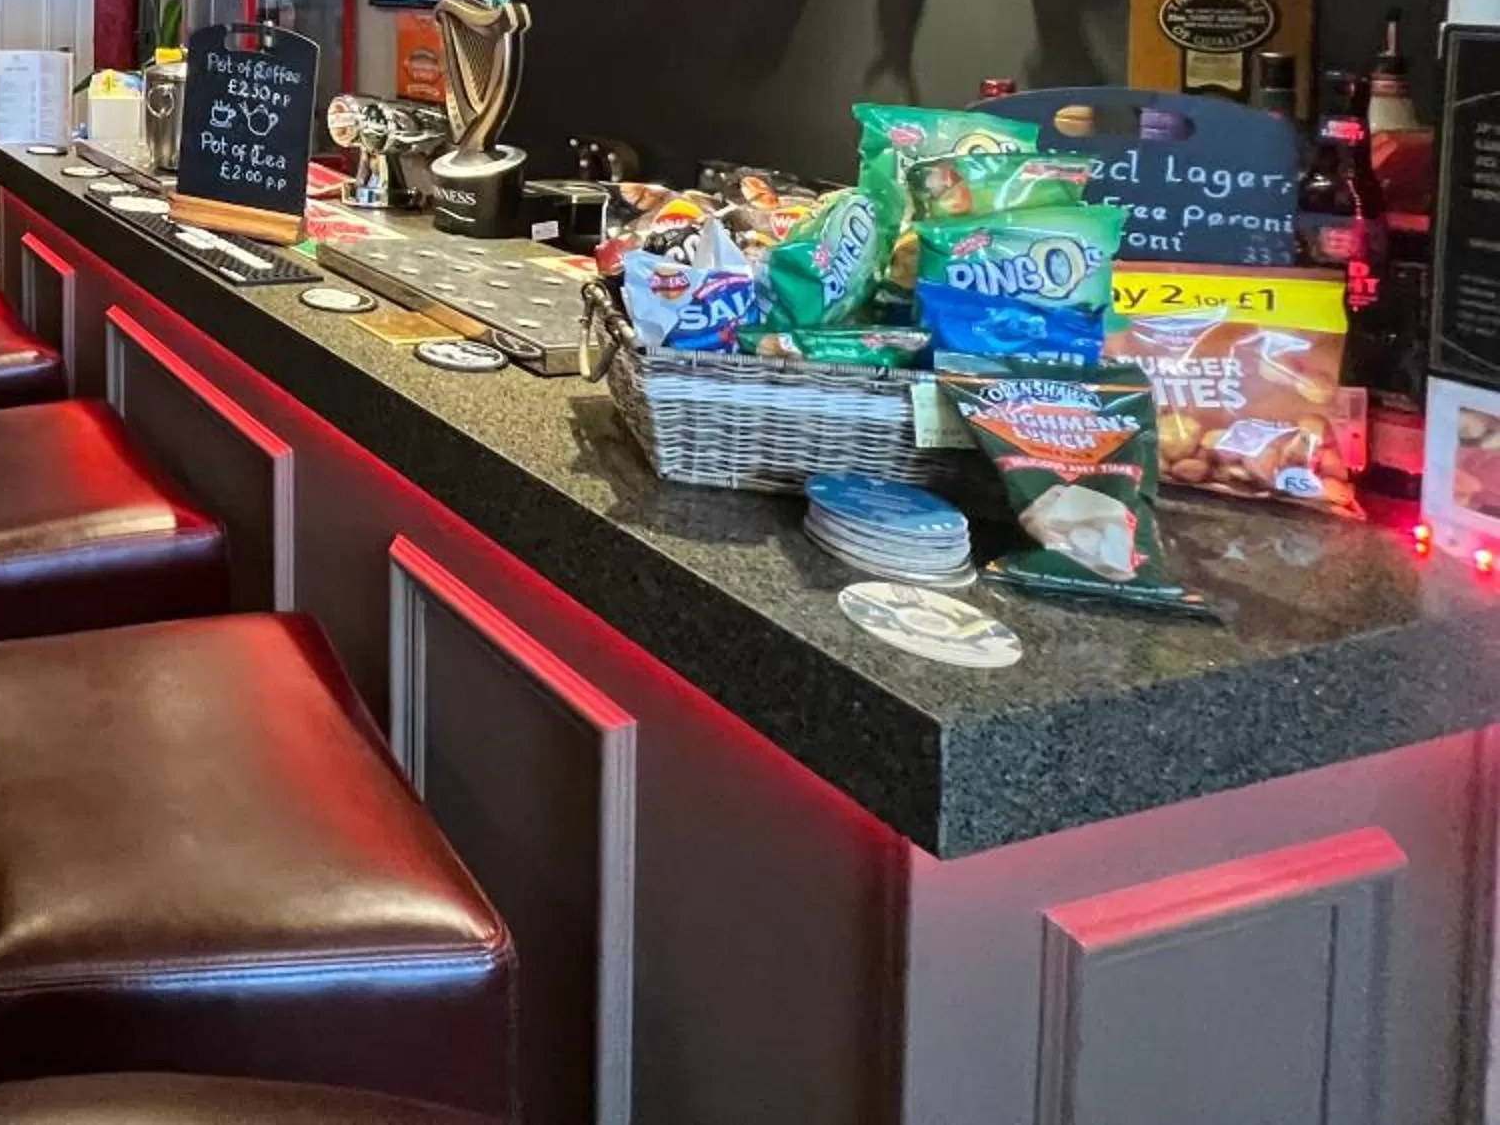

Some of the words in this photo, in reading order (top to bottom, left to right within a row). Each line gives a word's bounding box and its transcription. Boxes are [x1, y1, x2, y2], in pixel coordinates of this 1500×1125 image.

[1172, 26, 1191, 40] OF
[1193, 30, 1257, 45] QUALITY
[207, 52, 233, 74] Pot
[237, 59, 252, 79] of
[253, 61, 301, 84] Coffee
[201, 131, 227, 155] Pot
[231, 144, 247, 162] of
[251, 144, 287, 170] Tea
[1182, 205, 1295, 234] Peroni
[1160, 284, 1185, 305] 2
[1239, 287, 1276, 312] £1
[1116, 355, 1245, 378] URGER
[1151, 377, 1248, 410] ITES
[1011, 424, 1097, 450] LUNCH
